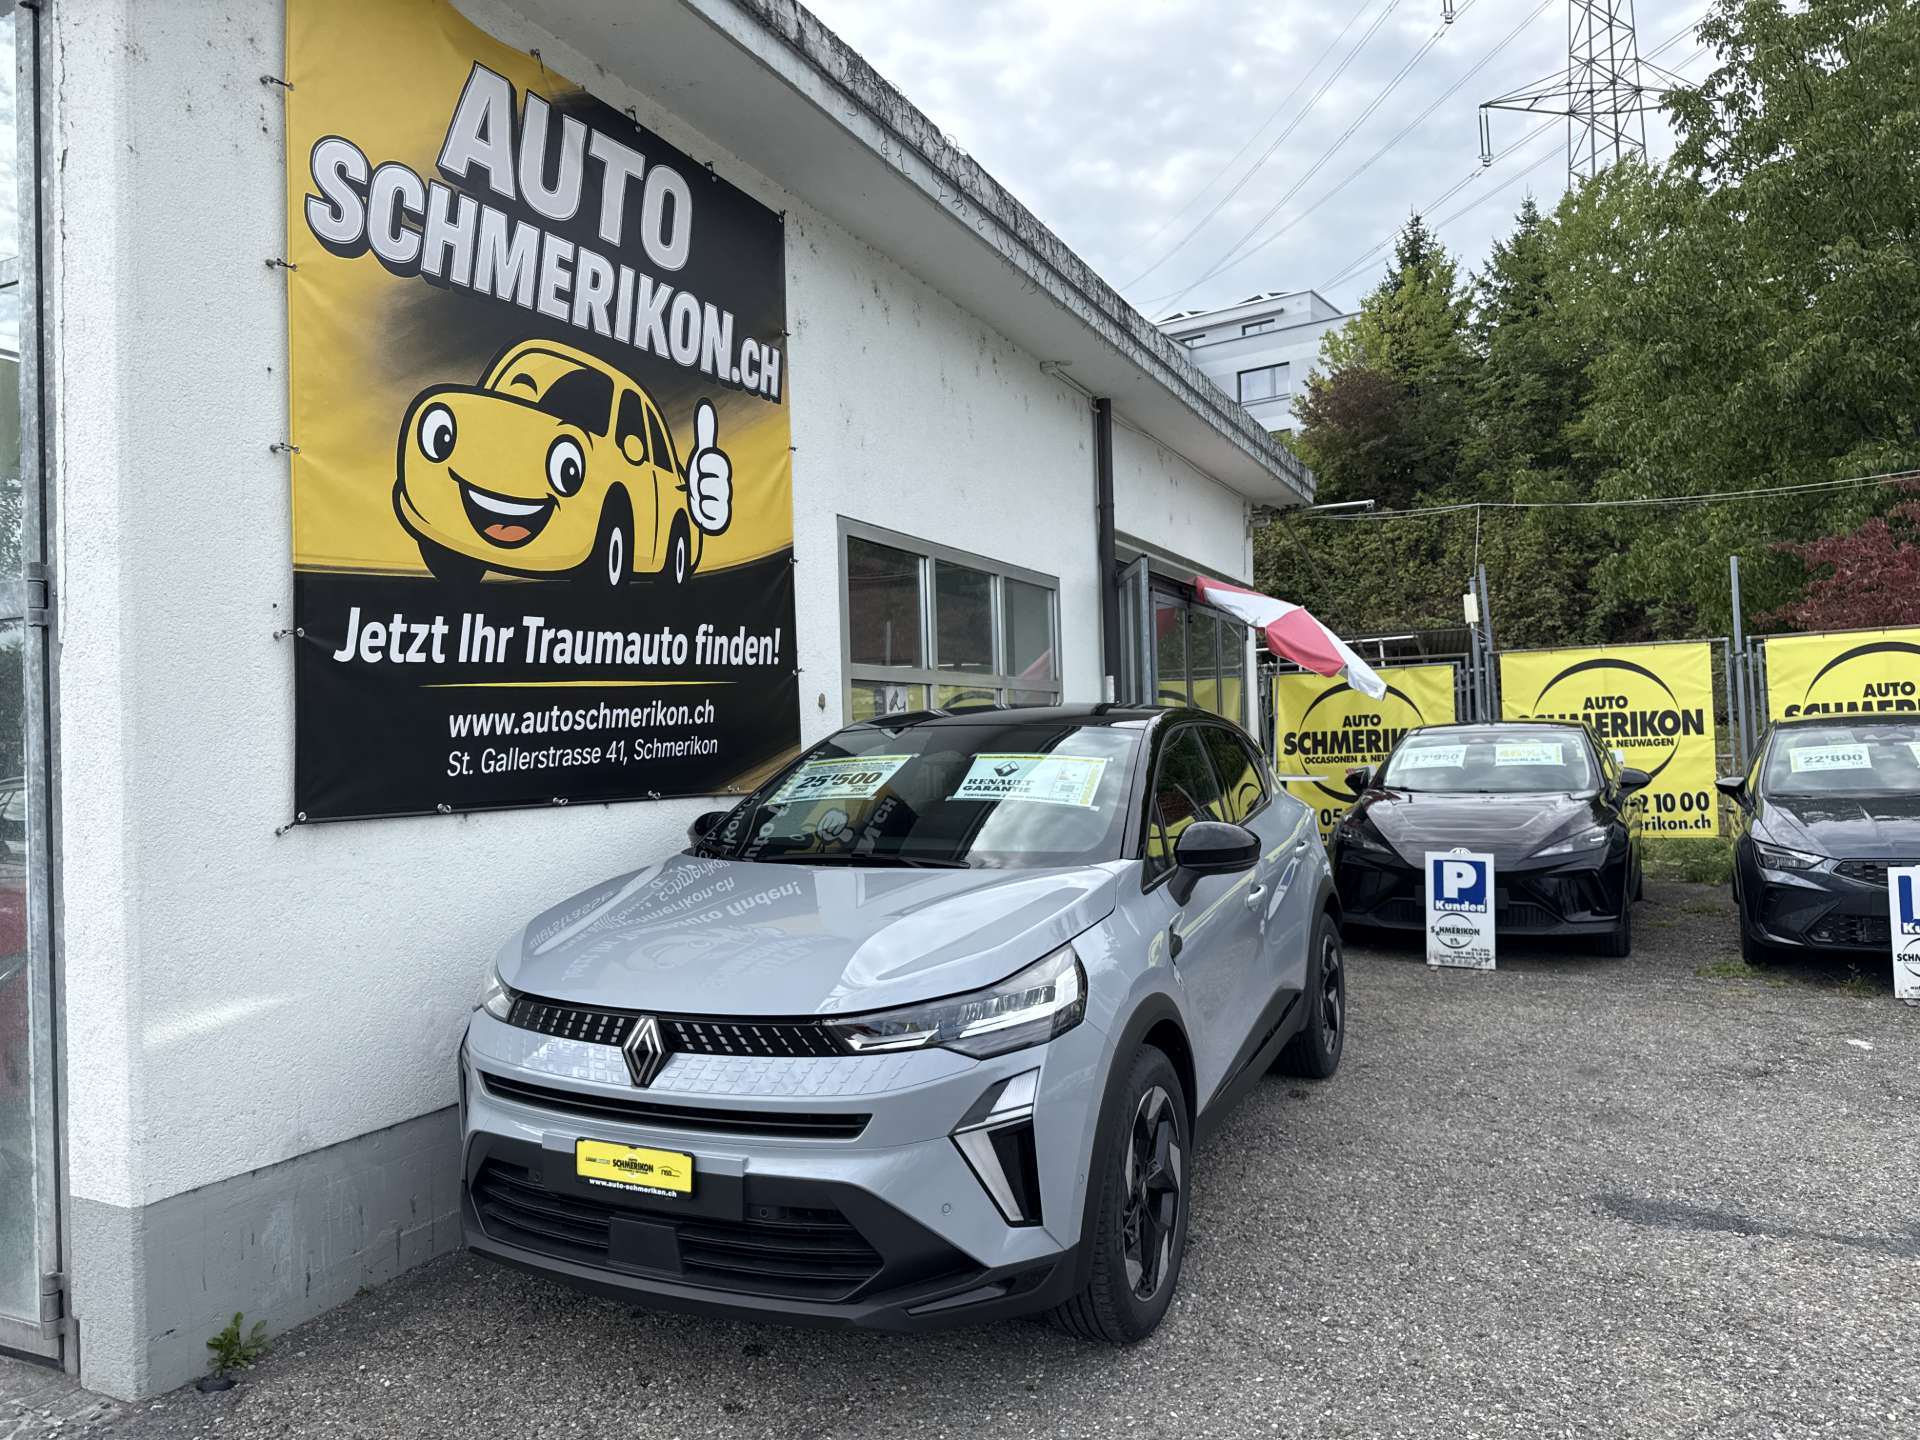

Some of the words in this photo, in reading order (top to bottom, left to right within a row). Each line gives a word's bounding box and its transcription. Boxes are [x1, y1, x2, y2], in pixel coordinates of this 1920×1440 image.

[438, 62, 692, 272] AUTO
[306, 137, 782, 398] SCHMERIKON.CH
[333, 606, 448, 664] Jetzt
[458, 613, 514, 664] Ihr
[522, 615, 688, 666] Traumauto
[695, 624, 781, 665] finden!
[1863, 682, 1916, 698] AUTO
[1583, 695, 1628, 710] AUTO
[449, 699, 715, 738] www.autoschmerikon.ch
[1342, 714, 1381, 728] AUTO
[1616, 737, 1675, 749] NEUWAGEN
[447, 750, 473, 777] St.
[481, 741, 601, 773] Gallerstrasse
[606, 740, 628, 767] 41,
[633, 735, 718, 761] Schmerikon
[1304, 755, 1357, 765] OCCASIONEN
[1360, 754, 1368, 763] &
[796, 772, 883, 789] 25'500
[1443, 861, 1477, 899] P
[1435, 900, 1486, 912] Kunden
[1430, 925, 1480, 936] SHMERIKON
[612, 1158, 654, 1173] SCHMERIKON
[588, 1178, 678, 1198] www.auto-schmerikon.ch
